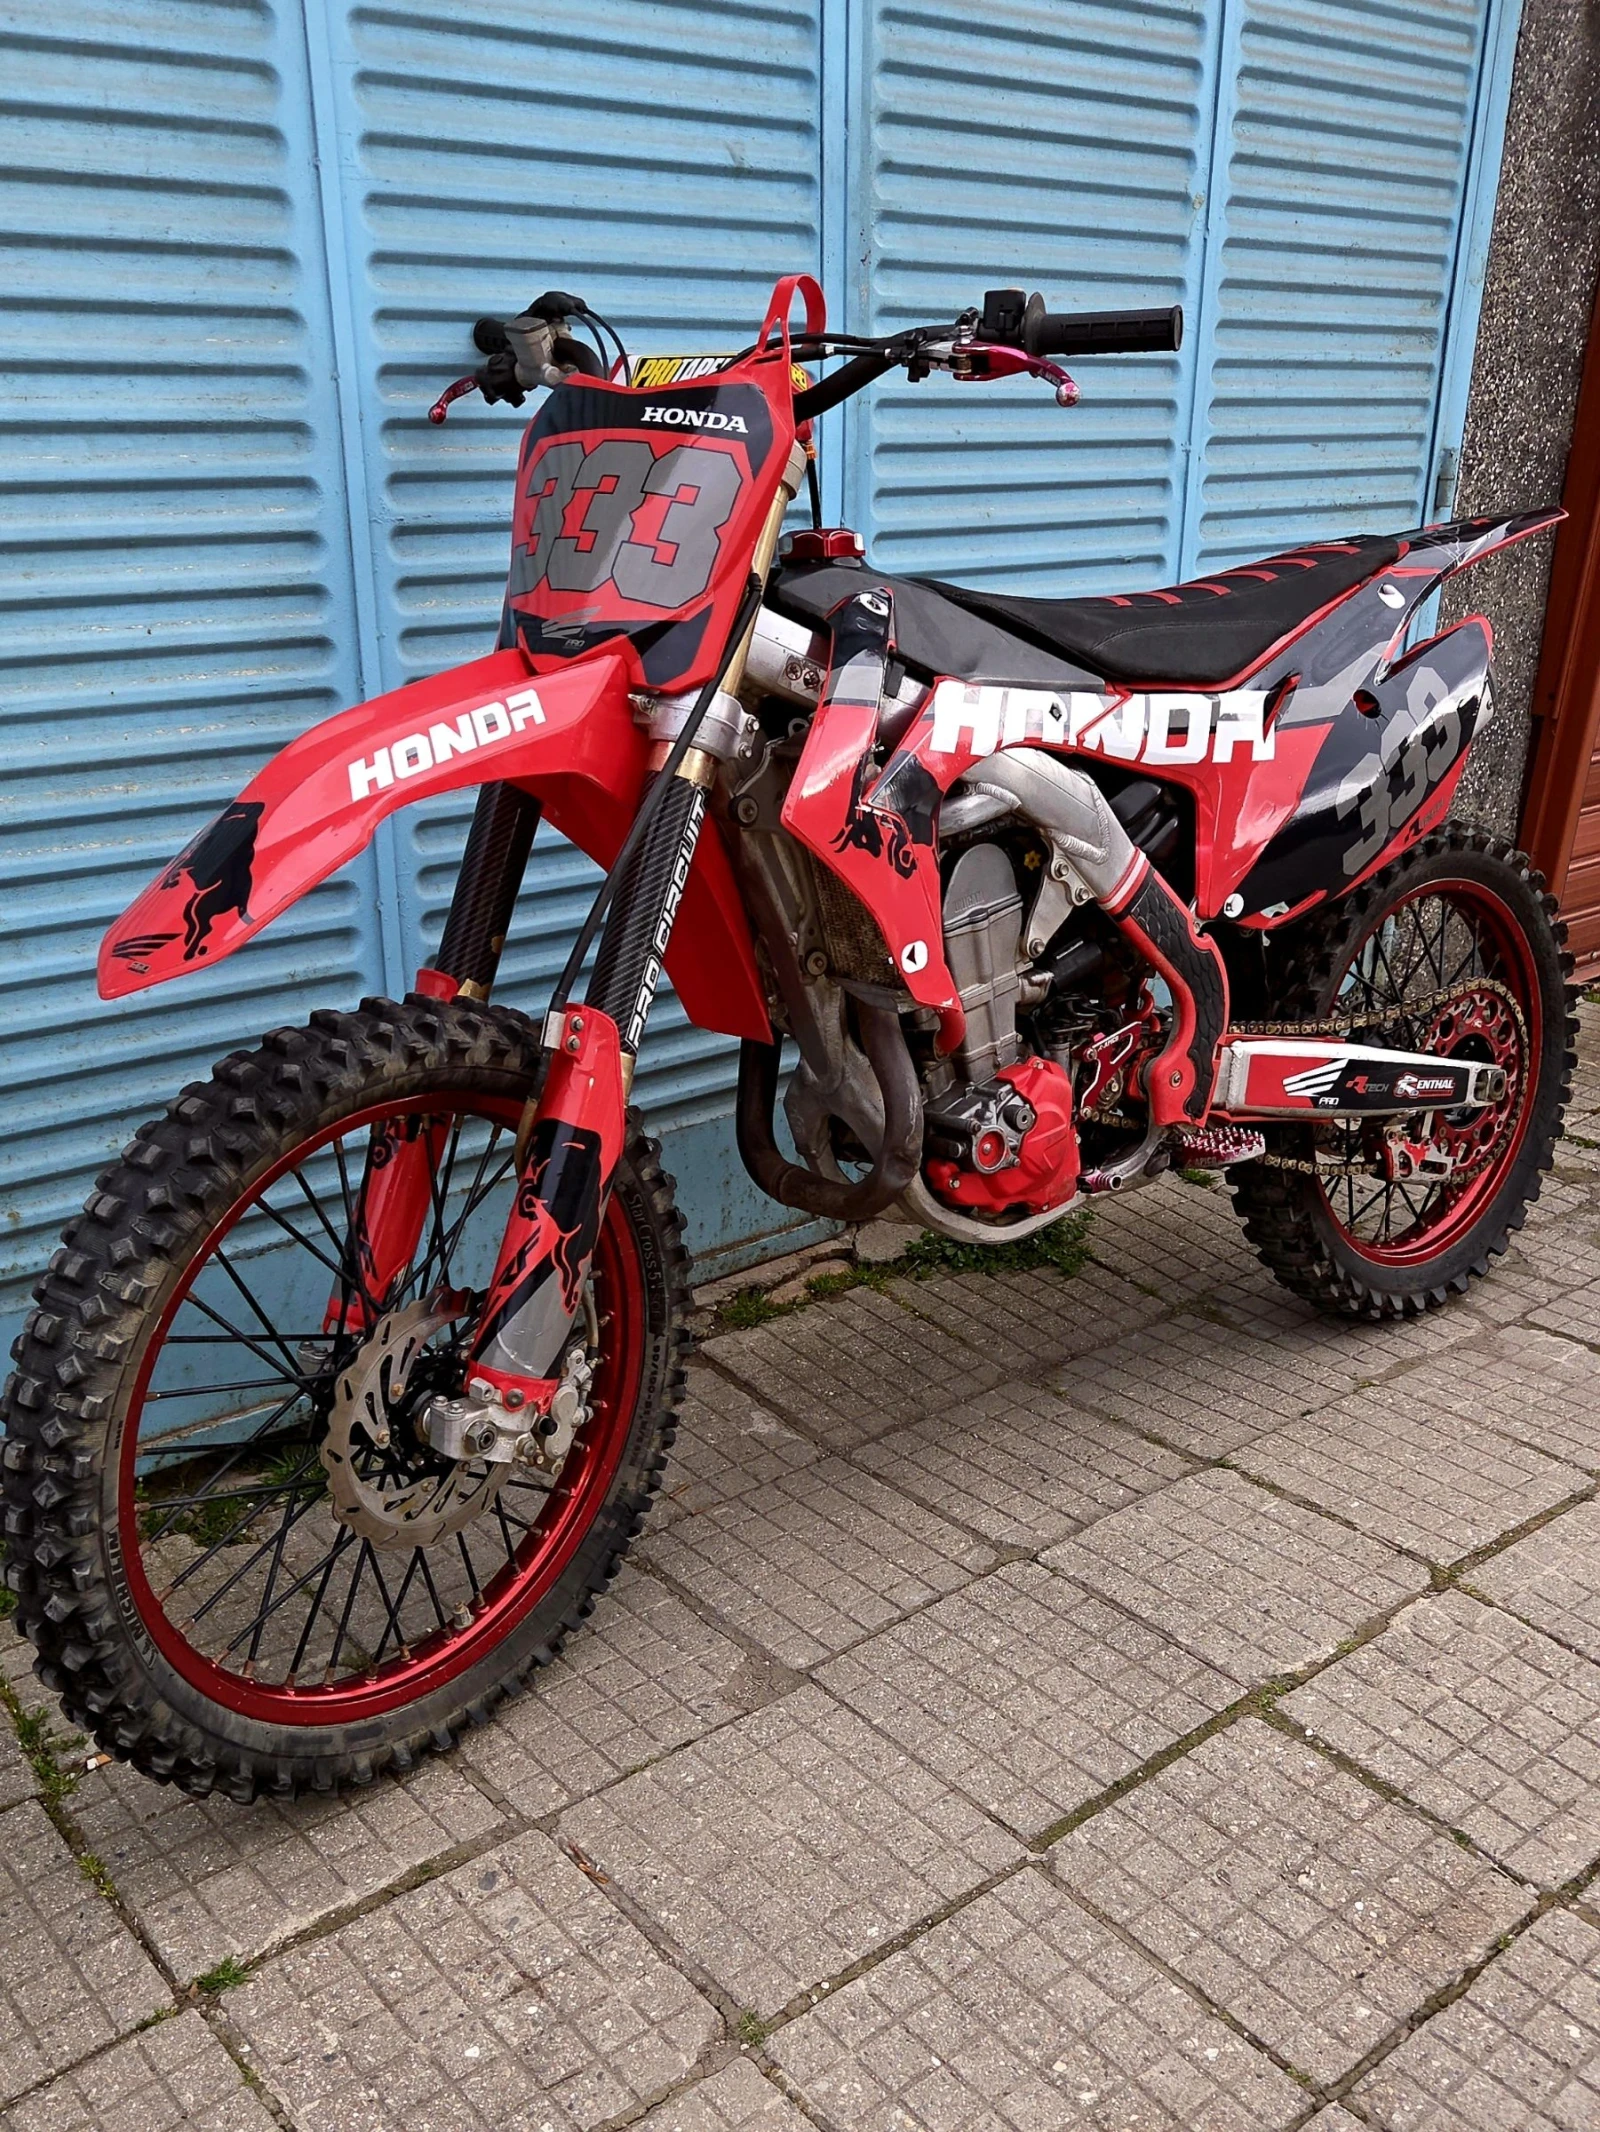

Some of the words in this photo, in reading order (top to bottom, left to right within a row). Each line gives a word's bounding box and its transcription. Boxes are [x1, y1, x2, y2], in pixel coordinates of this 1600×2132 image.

[640, 406, 749, 434] HONDA
[510, 440, 744, 609] 333
[347, 688, 547, 802] HONDA
[929, 679, 1276, 766] HONDA
[1335, 666, 1462, 876] 333
[625, 955, 661, 1051] PRO
[653, 786, 706, 957] CIRCUIT
[1318, 1096, 1340, 1106] PRO
[1396, 1073, 1455, 1098] RENTHAL
